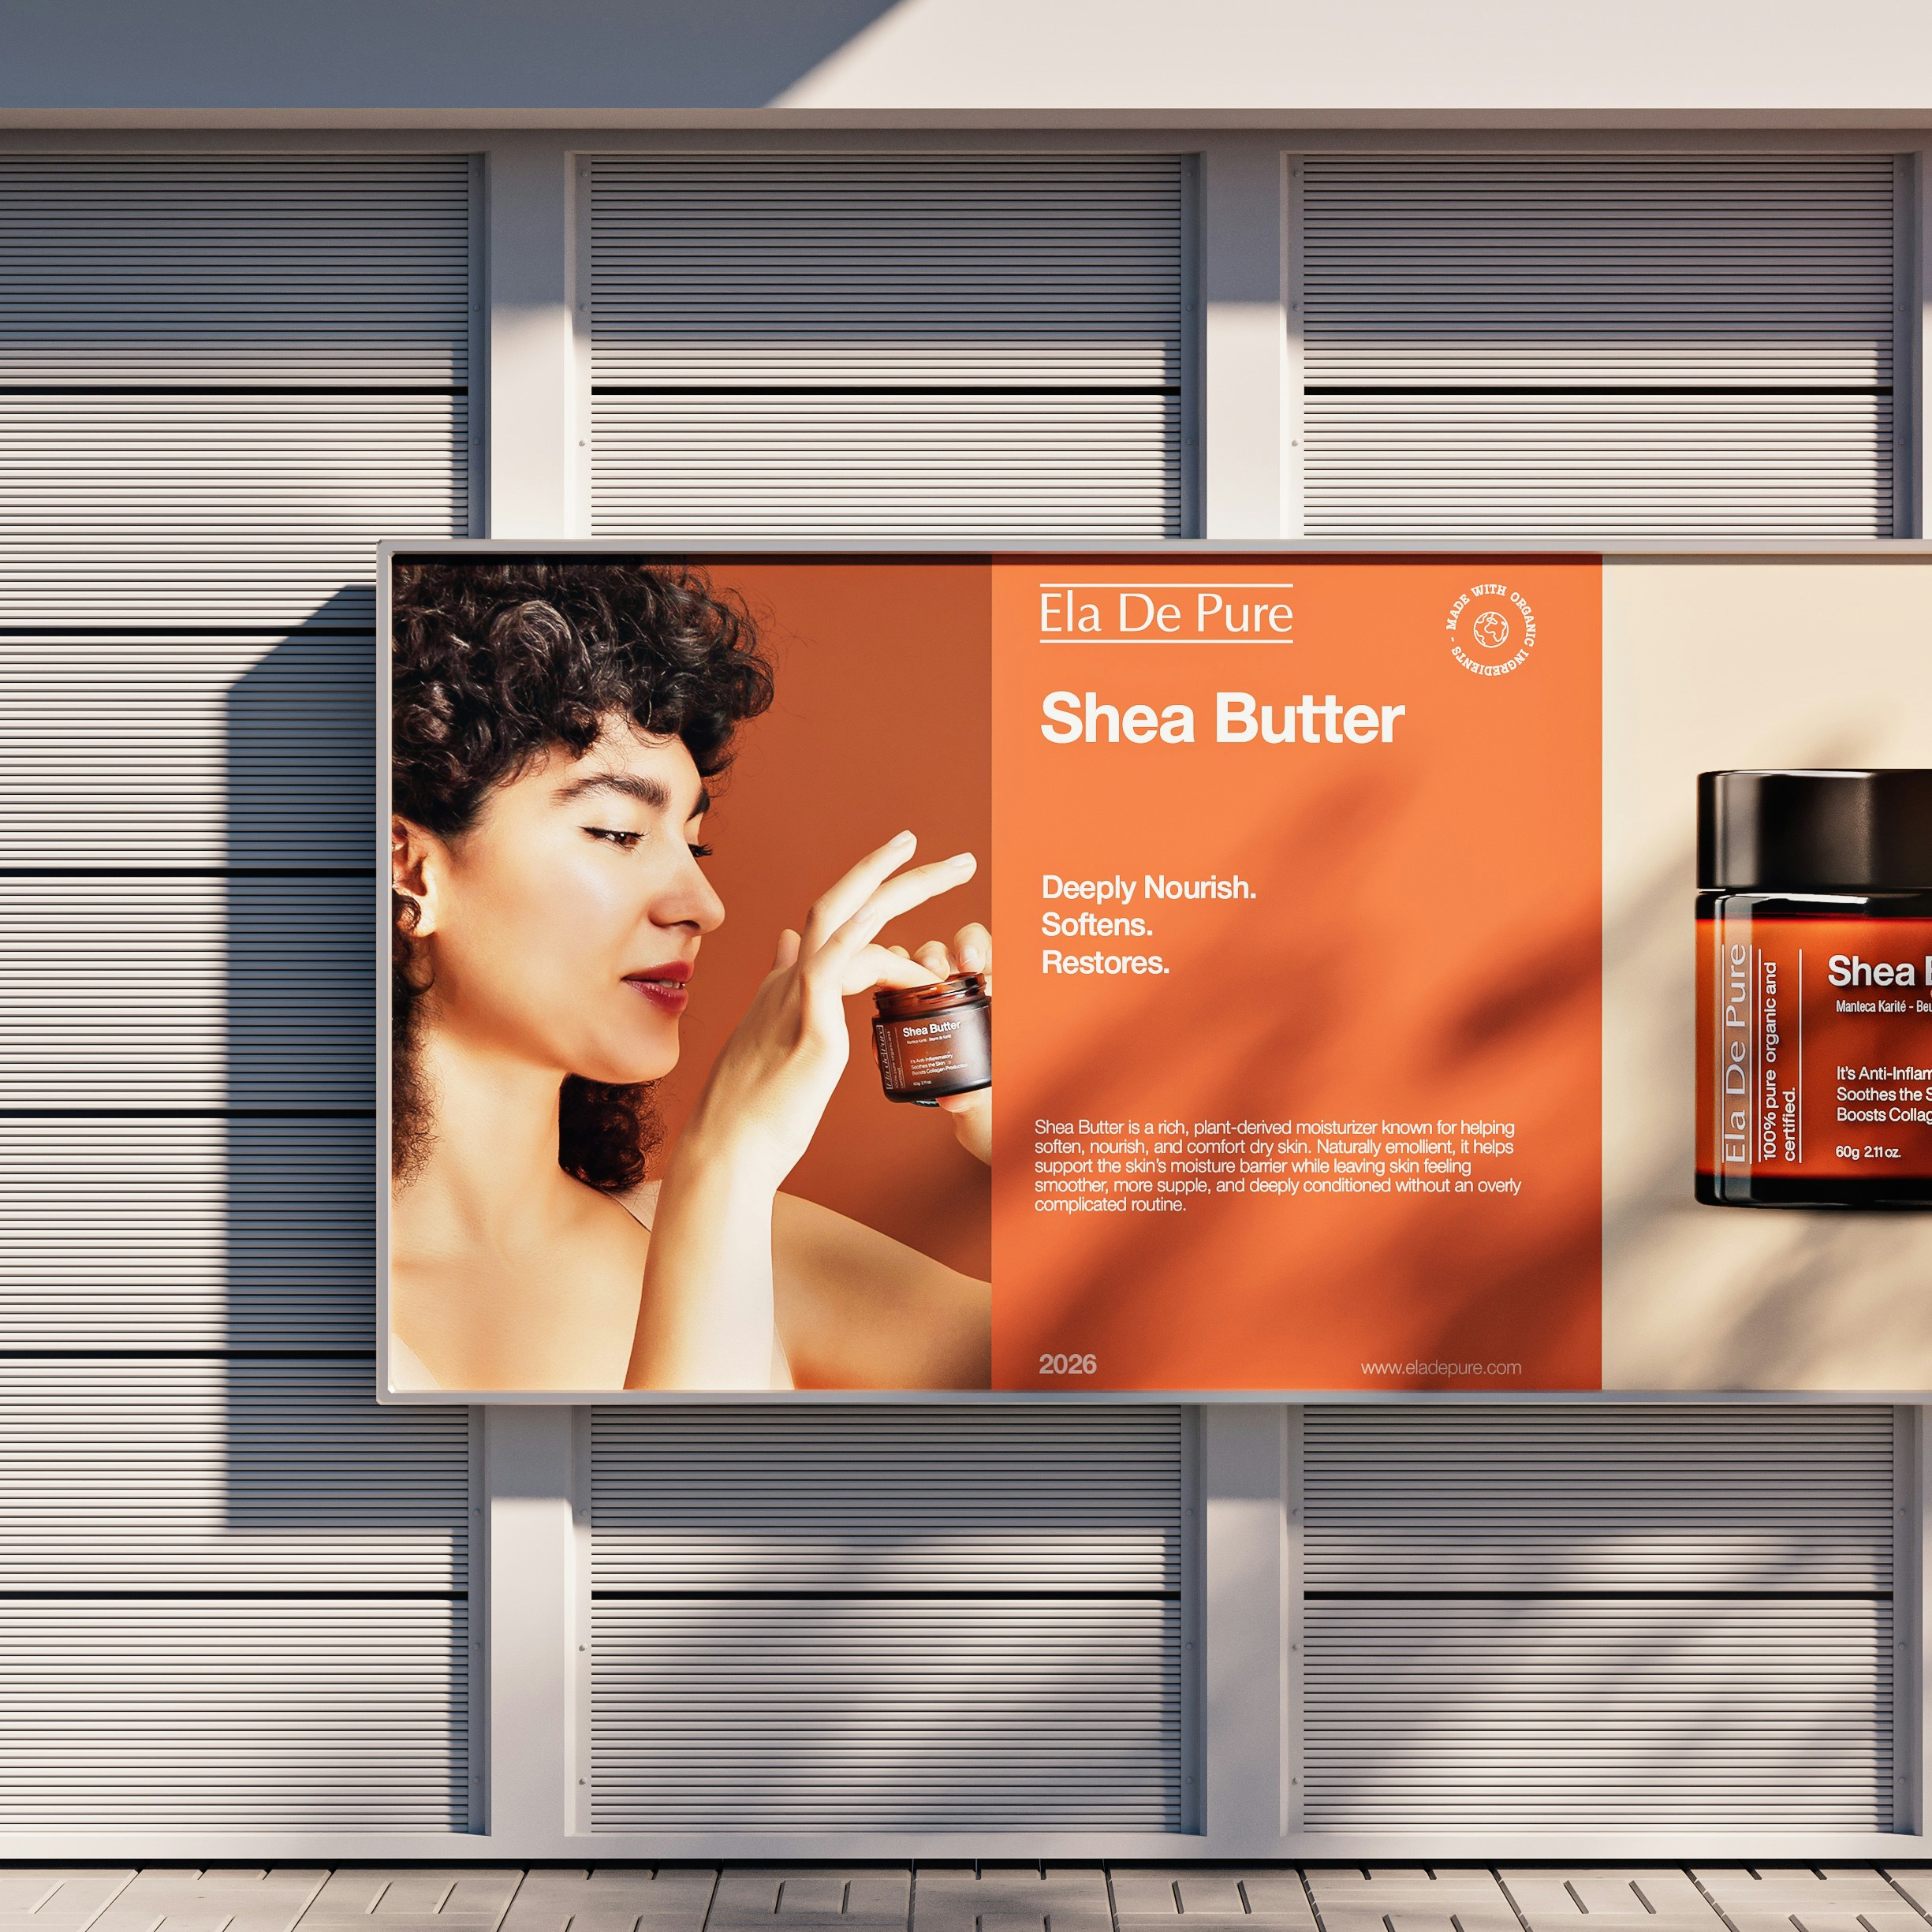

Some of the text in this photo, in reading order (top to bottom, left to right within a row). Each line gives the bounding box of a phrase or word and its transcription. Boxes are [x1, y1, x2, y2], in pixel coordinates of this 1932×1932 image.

[1471, 584, 1507, 597] WITH
[1041, 590, 1293, 632] Ela De Pure
[1446, 594, 1471, 630] MADE
[1510, 592, 1536, 647] ORGANIC
[1451, 646, 1529, 677] INGREDIENTS
[1041, 691, 1406, 744] Shea Butter
[1042, 875, 1257, 905] Deeply Nourish.
[1041, 912, 1154, 937] Softens.
[1042, 949, 1170, 975] Restores.
[1828, 954, 1915, 987] Shea
[1836, 999, 1876, 1013] Manteca
[1878, 999, 1907, 1013] Karité
[903, 1021, 961, 1038] Shea Butter
[1725, 944, 1746, 1163] Ela De Pure
[1763, 962, 1780, 1161] 100% pure organic and
[1837, 1086, 1897, 1101] Soothes
[1899, 1087, 1923, 1101] the
[1782, 1087, 1796, 1162] certified.
[1837, 1107, 1887, 1121] Boosts
[1035, 1119, 1516, 1138] Shea Butter is a rich, plant-derived moisturizer known for helping
[1035, 1139, 1514, 1157] soften, nourish, and comfort dry skin. Naturally emollient, it helps
[1835, 1145, 1901, 1161] 60g 2.11 oz.
[1035, 1159, 1093, 1177] support
[1097, 1158, 1121, 1173] the
[1171, 1158, 1236, 1173] moisture
[1240, 1158, 1289, 1173] barrier
[1291, 1158, 1330, 1173] while
[1333, 1158, 1386, 1177] leaving
[1389, 1158, 1420, 1173] skin
[1423, 1158, 1471, 1177] feeling
[1035, 1177, 1522, 1195] smoother, more supple, and deeply conditioned without an overly
[1035, 1196, 1188, 1214] complicated routine.
[1039, 1353, 1098, 1374] 2026
[1360, 1359, 1522, 1378] www.eladepure.com
